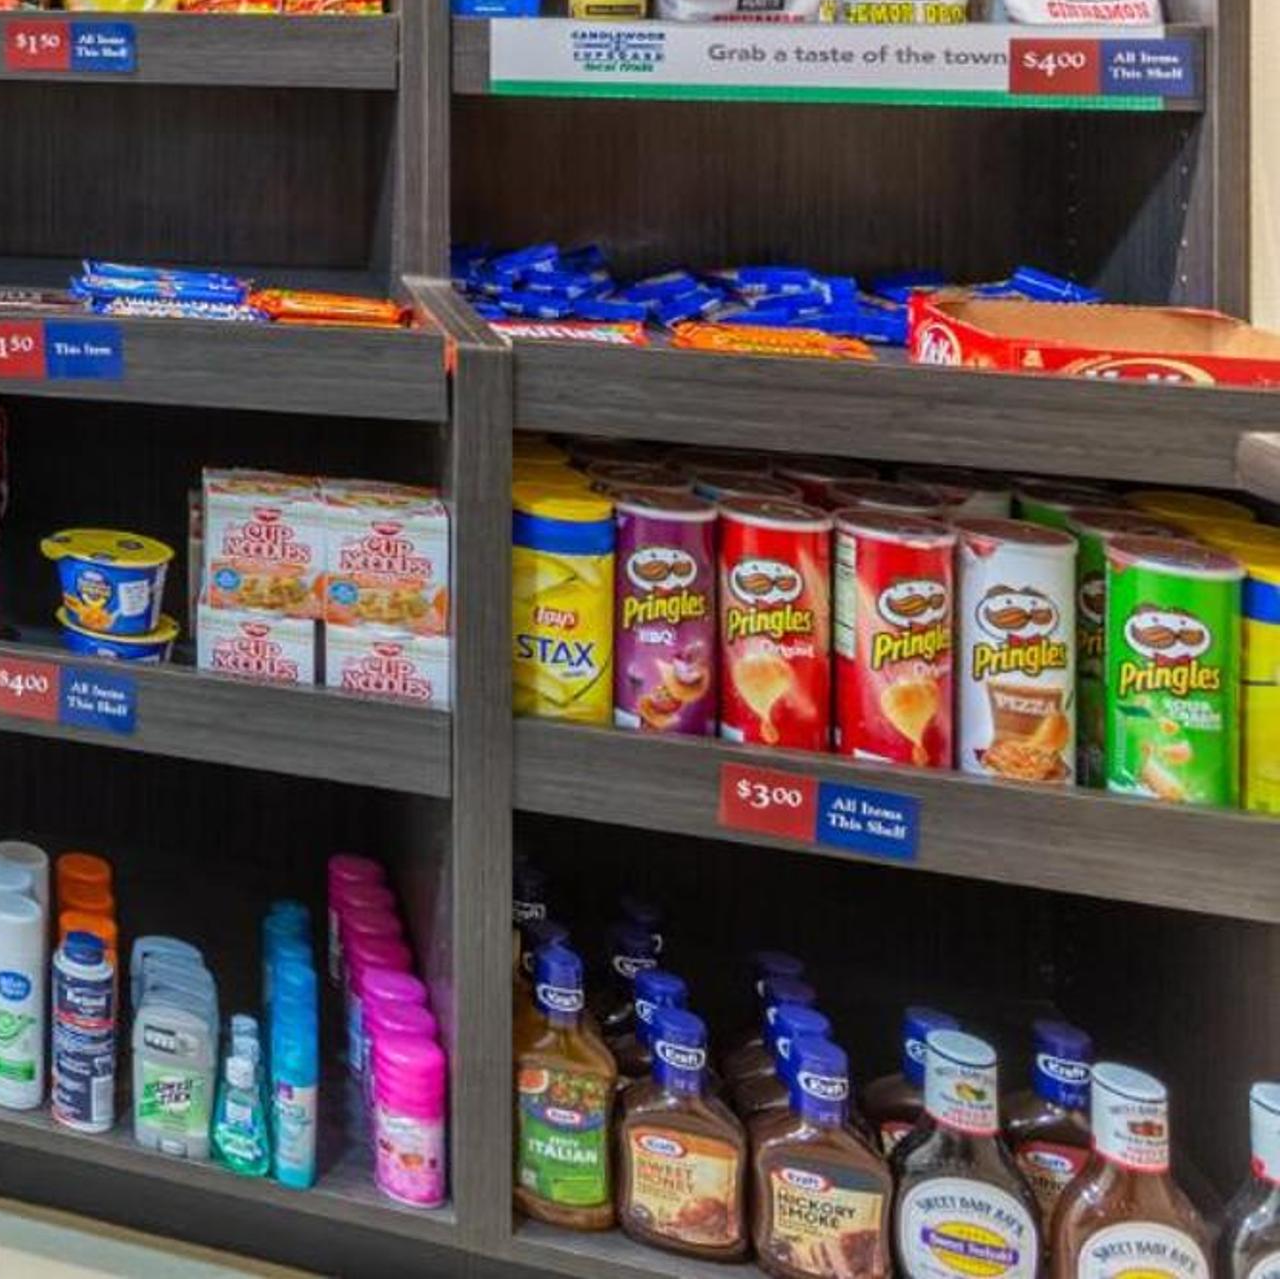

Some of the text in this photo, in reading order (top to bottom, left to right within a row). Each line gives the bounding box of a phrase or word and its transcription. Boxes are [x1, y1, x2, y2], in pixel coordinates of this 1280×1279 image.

[926, 1, 968, 25] DRO
[1046, 0, 1151, 20] CINNAMON
[78, 33, 95, 45] All
[707, 43, 1007, 66] Grab a taste of the town
[1113, 50, 1179, 65] All Items
[1109, 65, 1184, 81] This Shelf
[54, 342, 112, 358] This Item
[243, 523, 295, 546] CUP
[222, 535, 313, 564] NOODLES
[360, 536, 414, 559] CUP
[340, 549, 433, 576] NOODLES
[623, 592, 706, 629] Pringles
[727, 606, 814, 643] Pringles
[516, 635, 597, 668] STAX
[872, 625, 952, 671] Pringl
[972, 639, 1067, 679] Pringles
[361, 656, 416, 676] CUP
[70, 681, 88, 693] All
[342, 671, 433, 700] NOODLES
[1119, 660, 1221, 697] Pringles
[67, 695, 129, 717] This Shelf
[995, 688, 1059, 715] PIZZA
[832, 797, 904, 821] All Items
[827, 812, 908, 841] This Shelf
[546, 989, 579, 1008] Kraft
[664, 1045, 702, 1066] Kraft
[1047, 1060, 1090, 1080] Kraft
[805, 1076, 847, 1098] Kraft
[527, 1137, 599, 1164] ITALIAN
[777, 1190, 857, 1219] HICKORY
[778, 1203, 840, 1229] SMOKE
[916, 1194, 957, 1212] SWEET
[959, 1195, 993, 1215] BABY
[1093, 1241, 1137, 1263] SWEET
[1139, 1241, 1171, 1257] BABY
